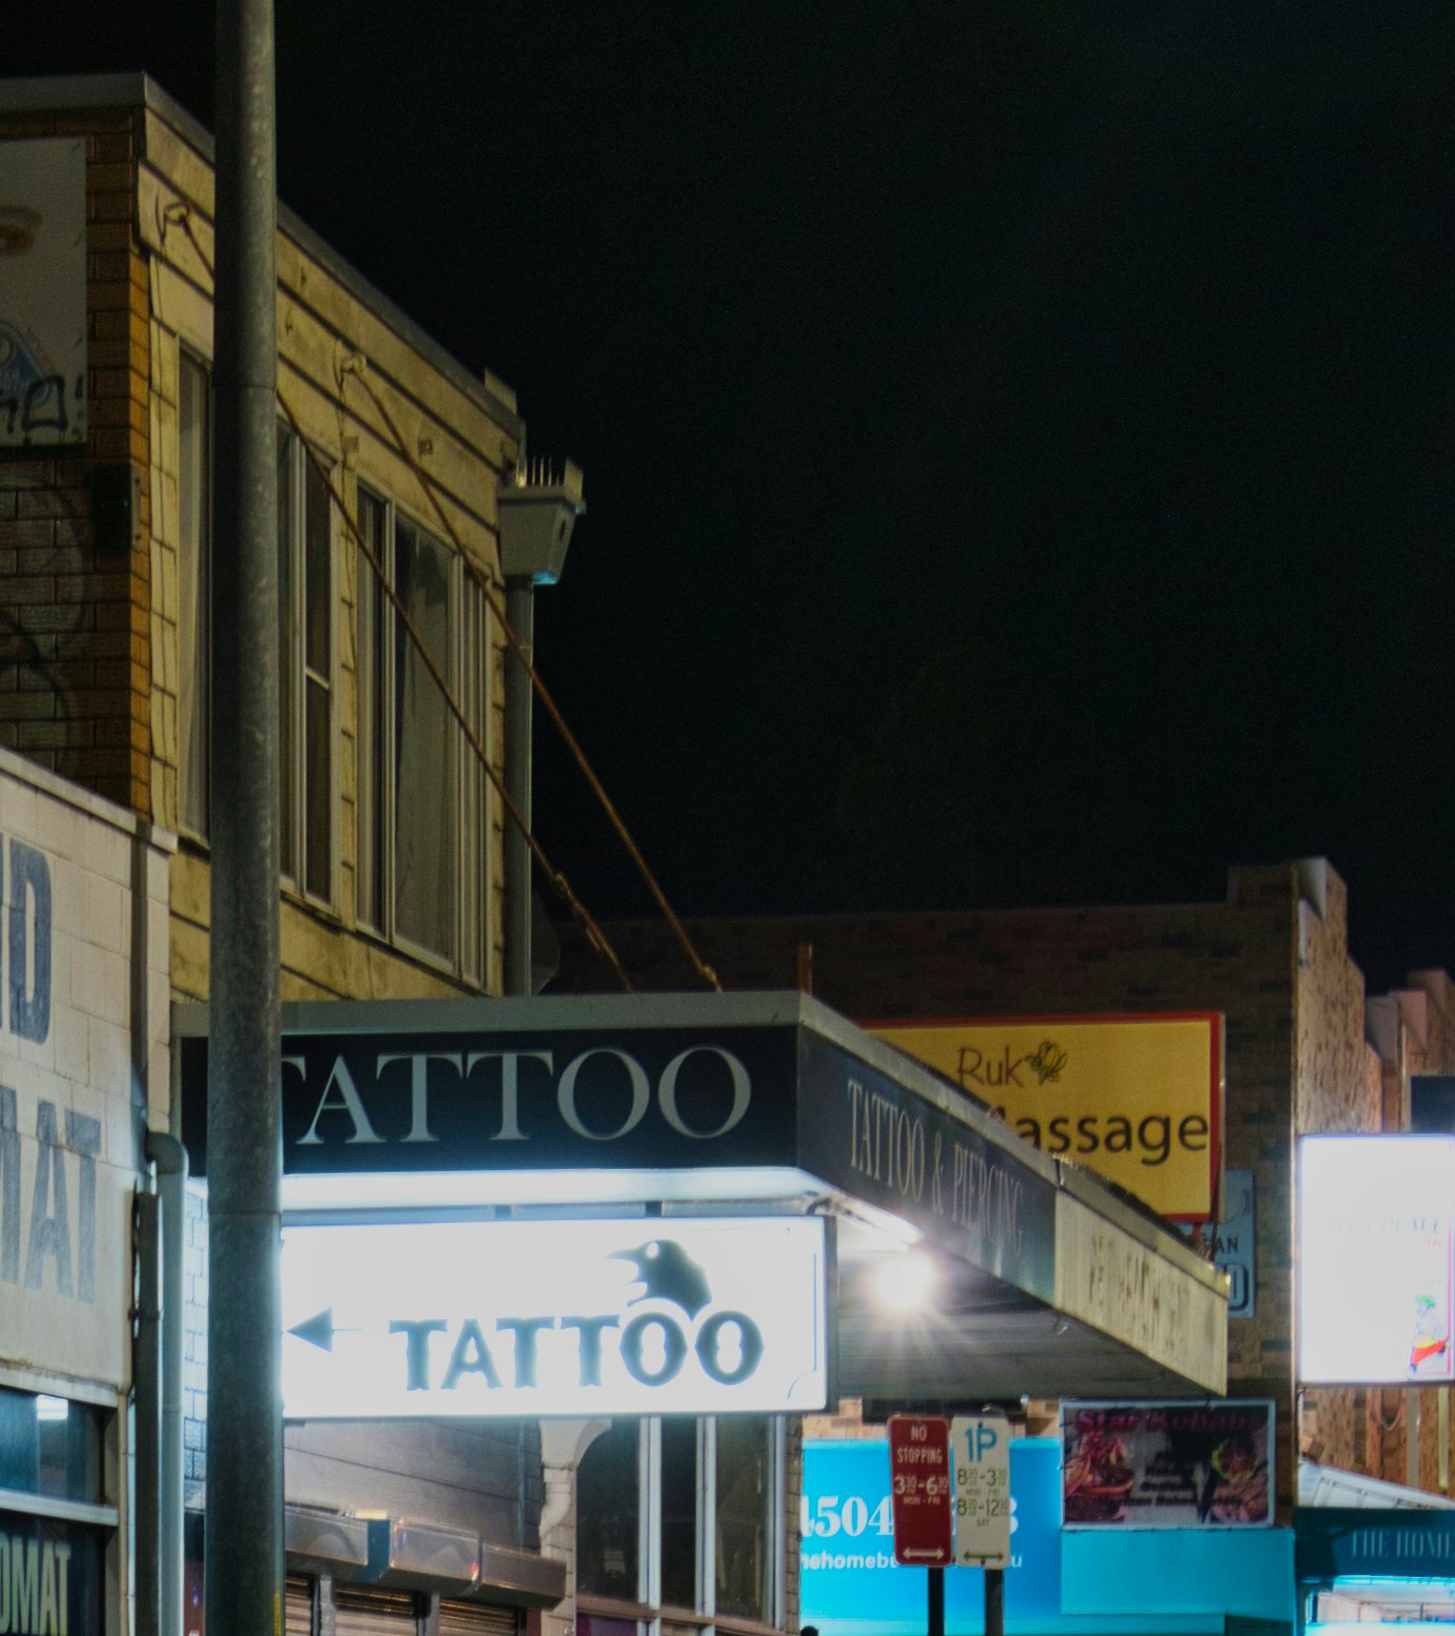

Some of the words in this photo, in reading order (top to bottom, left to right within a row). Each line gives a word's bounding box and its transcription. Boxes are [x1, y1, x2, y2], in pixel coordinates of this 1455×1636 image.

[957, 1043, 1026, 1088] Ruk
[996, 1105, 1209, 1166] assage
[847, 1077, 925, 1203] TATTOO
[931, 1129, 944, 1215] &
[953, 1142, 1024, 1258] PIERCING
[388, 1308, 765, 1392] TATTOO
[911, 1425, 928, 1442] NO
[965, 1426, 998, 1463] 1P
[896, 1447, 944, 1464] STOPPING
[1350, 1530, 1390, 1559] THE
[1396, 1530, 1455, 1560] HOME
